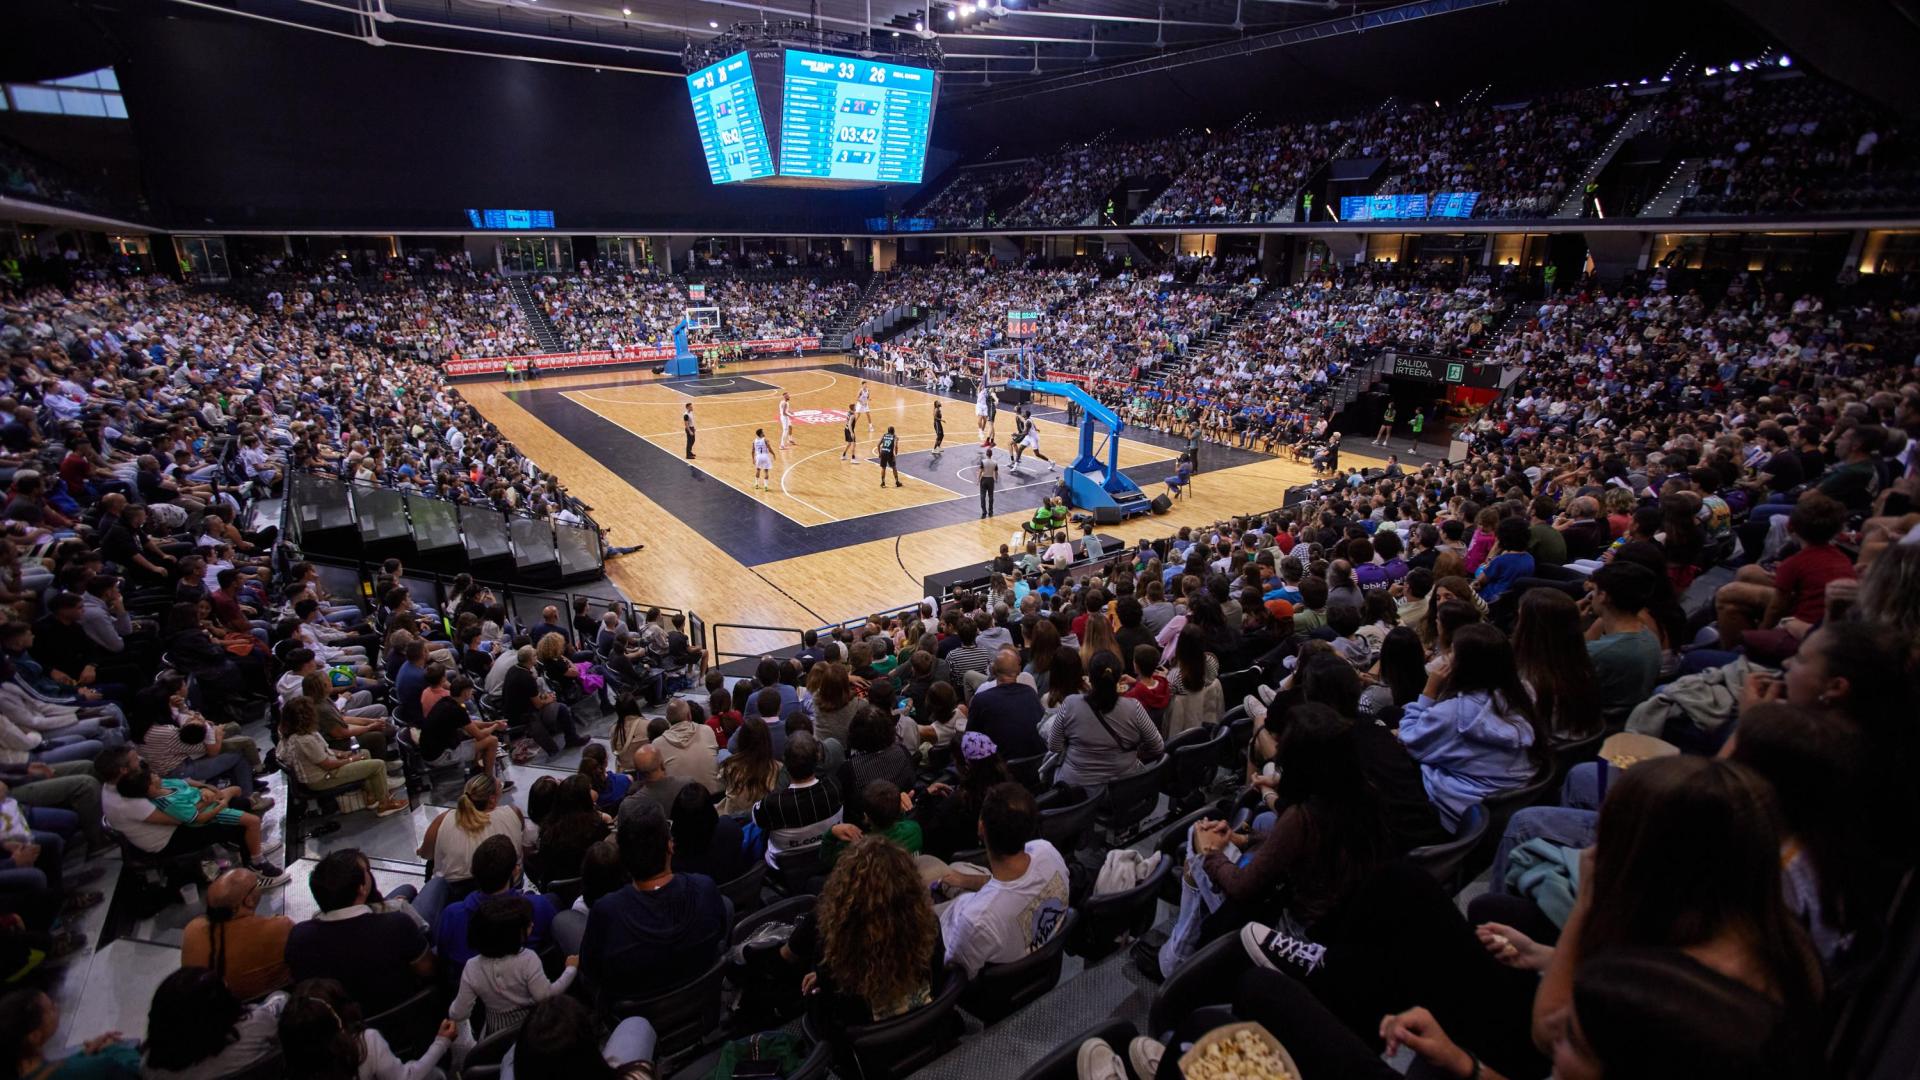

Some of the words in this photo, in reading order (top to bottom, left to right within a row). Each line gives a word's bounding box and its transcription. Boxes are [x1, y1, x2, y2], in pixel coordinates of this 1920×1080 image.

[838, 62, 855, 79] 33
[869, 66, 886, 83] 26
[840, 126, 876, 143] 03:42
[840, 150, 848, 161] 3
[863, 152, 871, 163] 2
[1021, 322, 1037, 333] 3.4
[1396, 359, 1428, 368] SALIDA
[1395, 366, 1433, 377] IRTEERA
